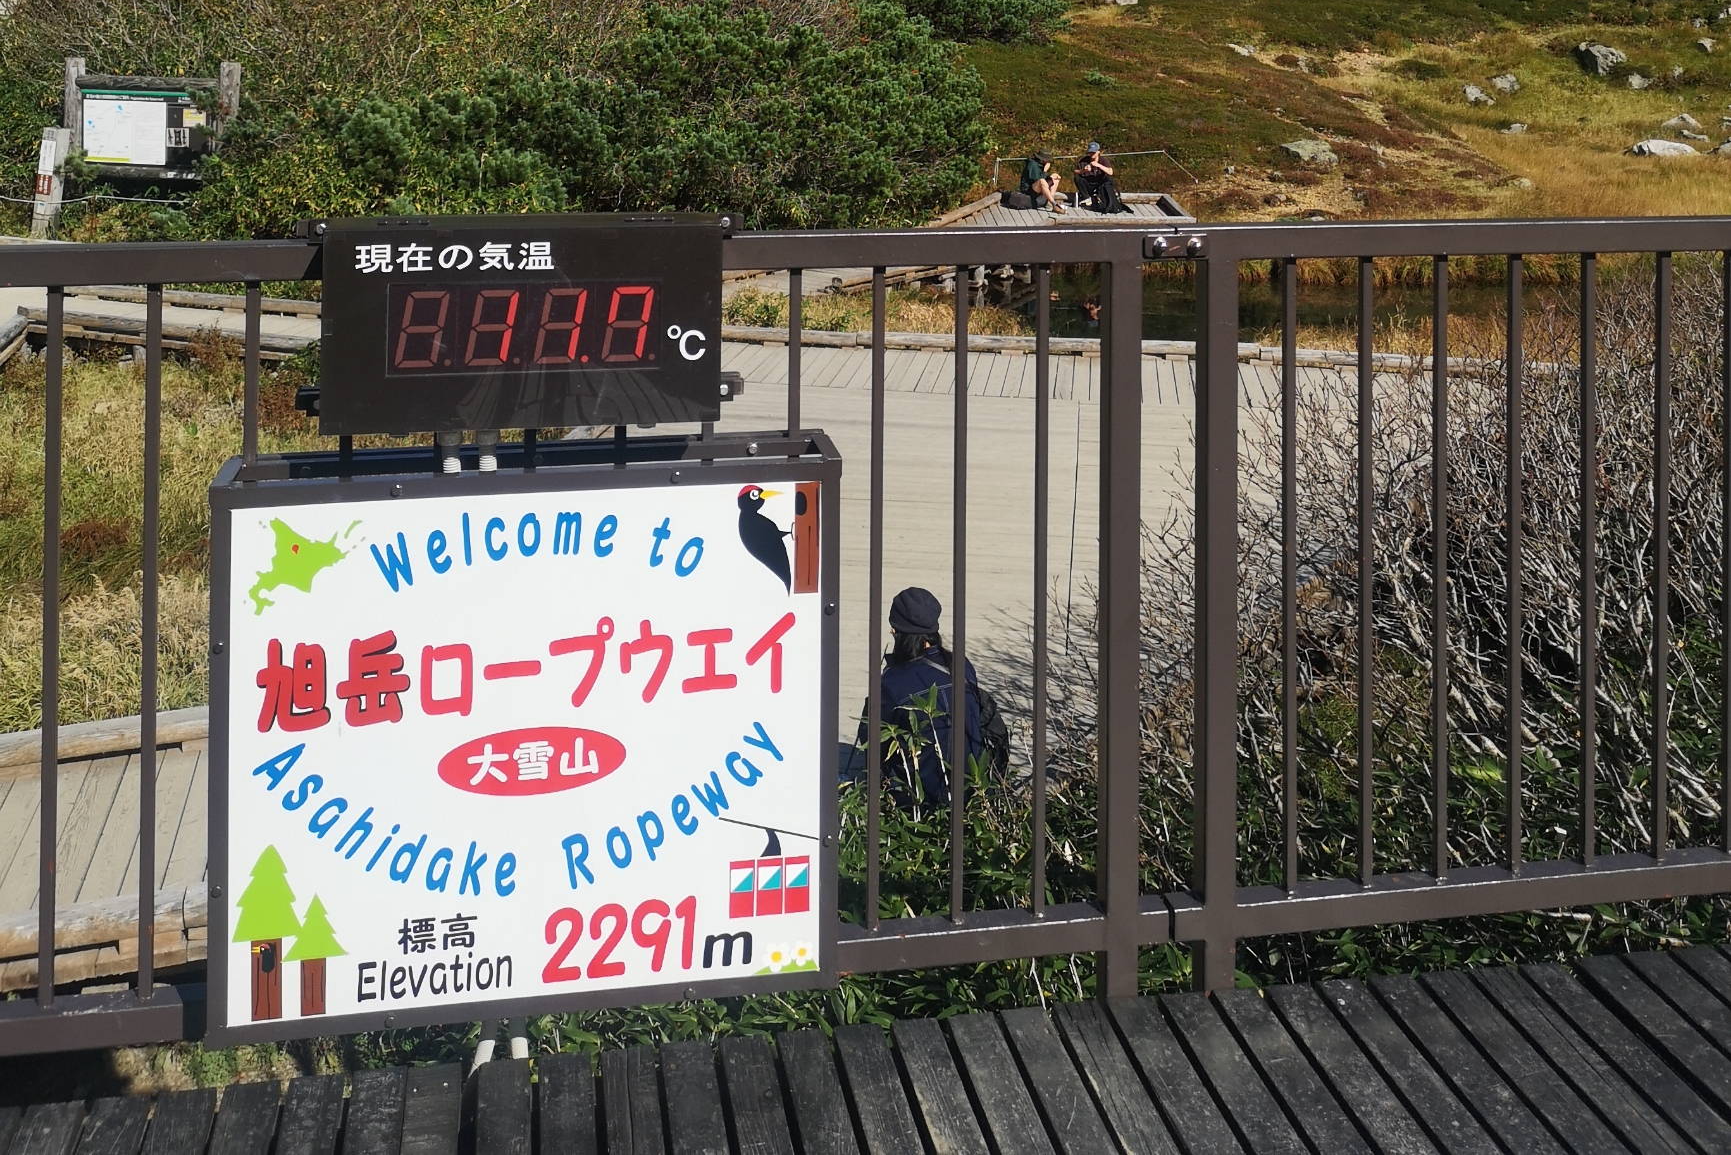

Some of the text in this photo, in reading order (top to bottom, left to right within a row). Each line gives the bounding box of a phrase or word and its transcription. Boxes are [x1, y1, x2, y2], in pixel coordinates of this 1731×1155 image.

[355, 241, 554, 274] 現在の気温
[370, 511, 704, 593] Welcome to
[256, 612, 796, 733] 旭岳ロープウエイ
[466, 737, 600, 783] 大雪山
[252, 721, 784, 898] Asahidake Ropeway
[398, 913, 478, 954] 標高
[357, 952, 513, 1003] Elevation
